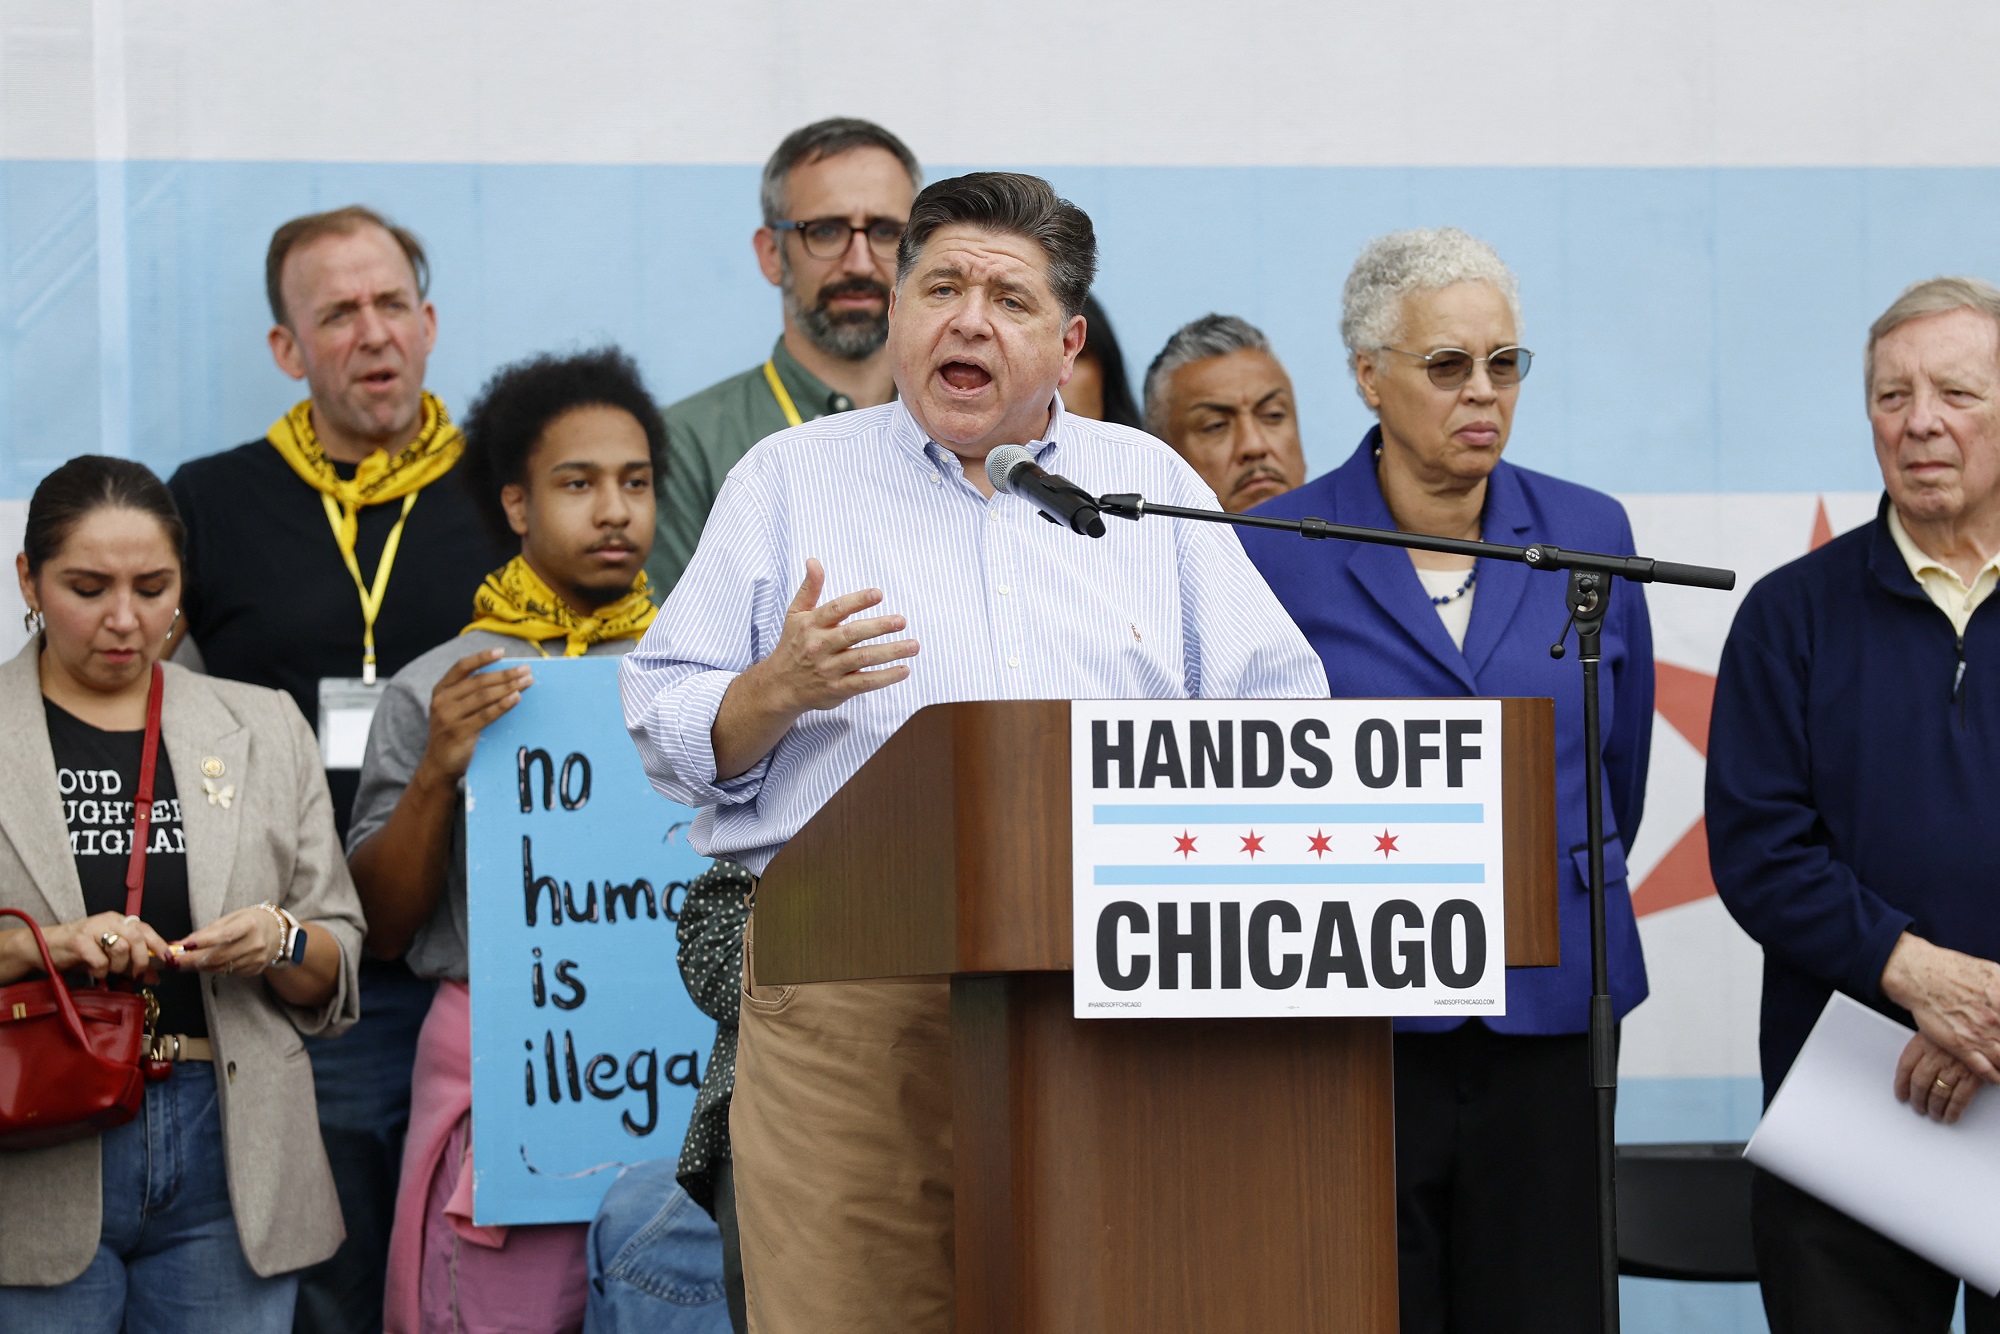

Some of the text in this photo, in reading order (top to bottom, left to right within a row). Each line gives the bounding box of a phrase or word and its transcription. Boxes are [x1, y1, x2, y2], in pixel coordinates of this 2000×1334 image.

[516, 746, 592, 814] no
[1091, 718, 1482, 789] HANDS OFF
[532, 947, 587, 1011] is
[1096, 898, 1487, 992] CHICAGO
[1434, 998, 1495, 1006] HANDSOFFCHICAGO.COM
[524, 1029, 701, 1137] illega
